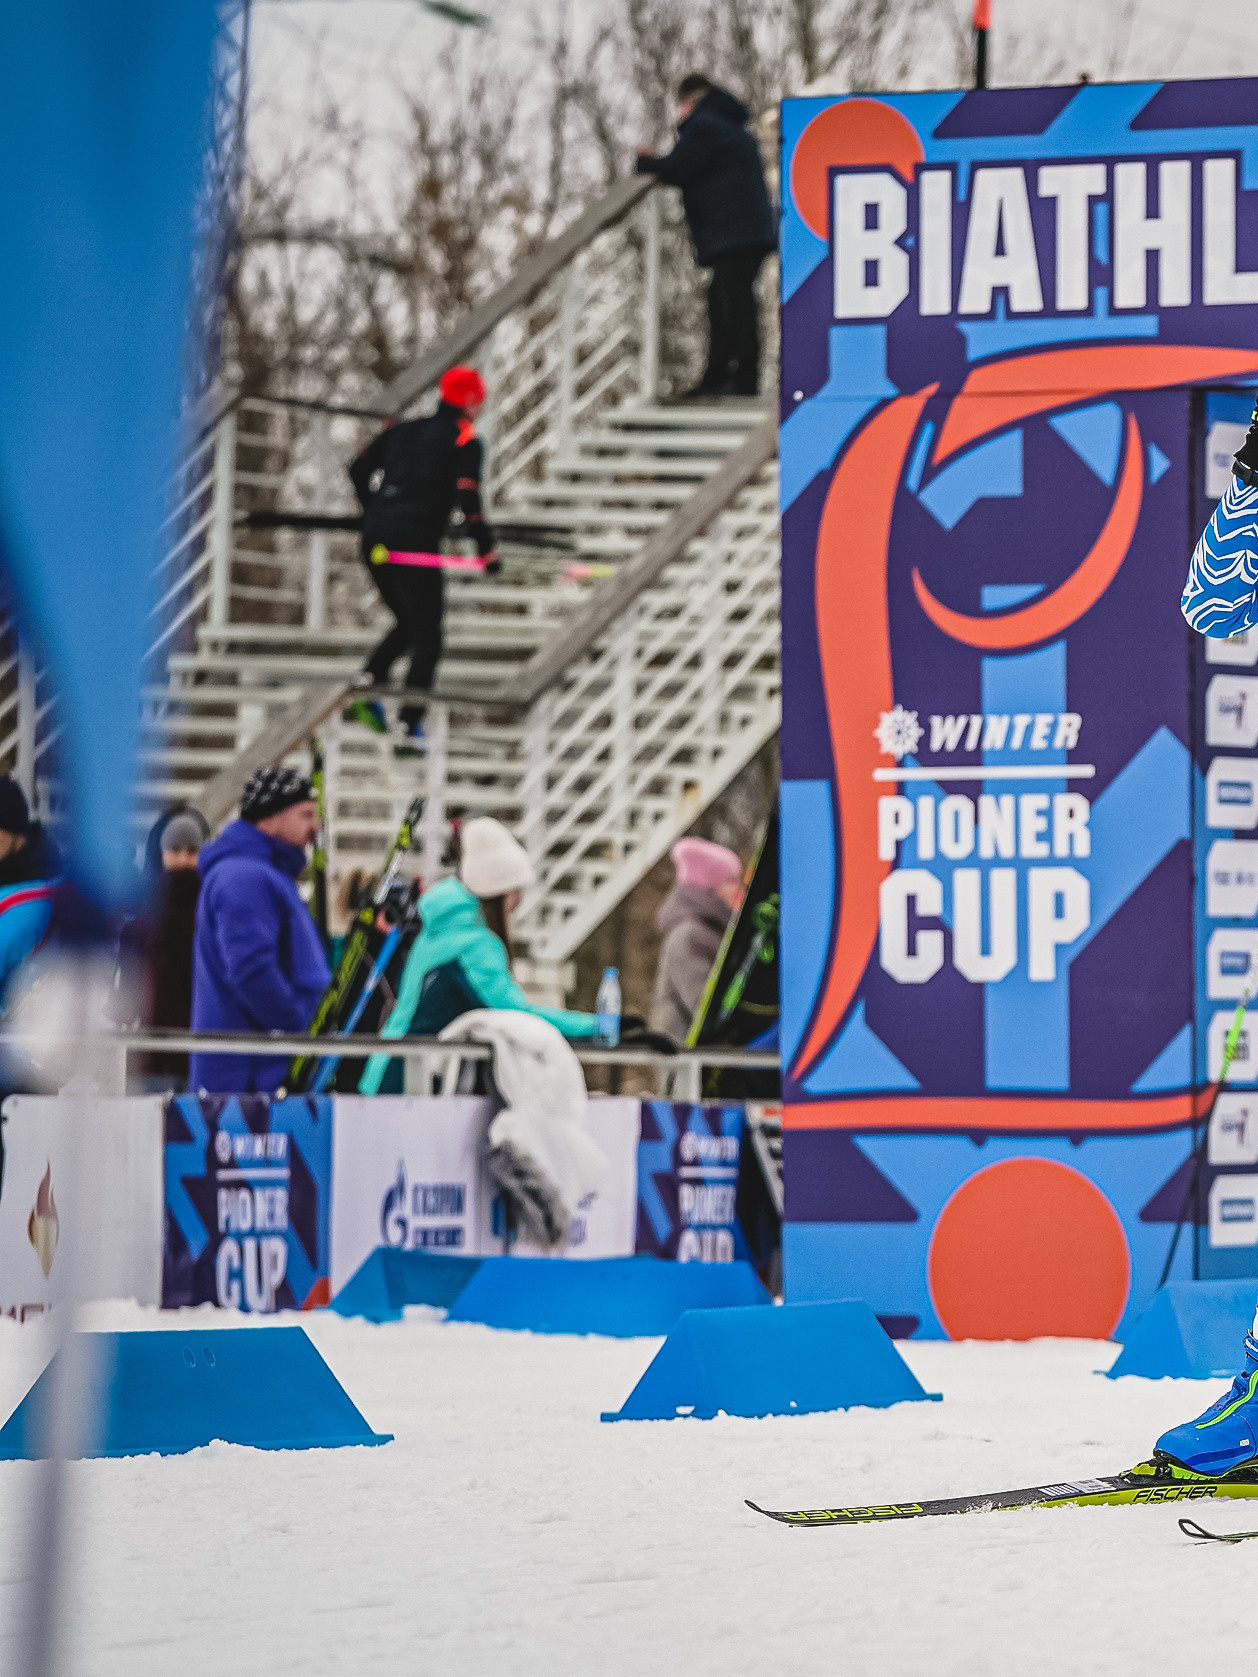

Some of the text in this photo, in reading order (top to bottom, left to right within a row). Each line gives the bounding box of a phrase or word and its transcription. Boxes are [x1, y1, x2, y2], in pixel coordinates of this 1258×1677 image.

[929, 712, 1083, 753] WINTER
[876, 792, 1092, 861] PIONER
[878, 866, 1092, 985] CUP
[215, 1236, 288, 1312] CUP
[1132, 1485, 1218, 1503] FISCHER
